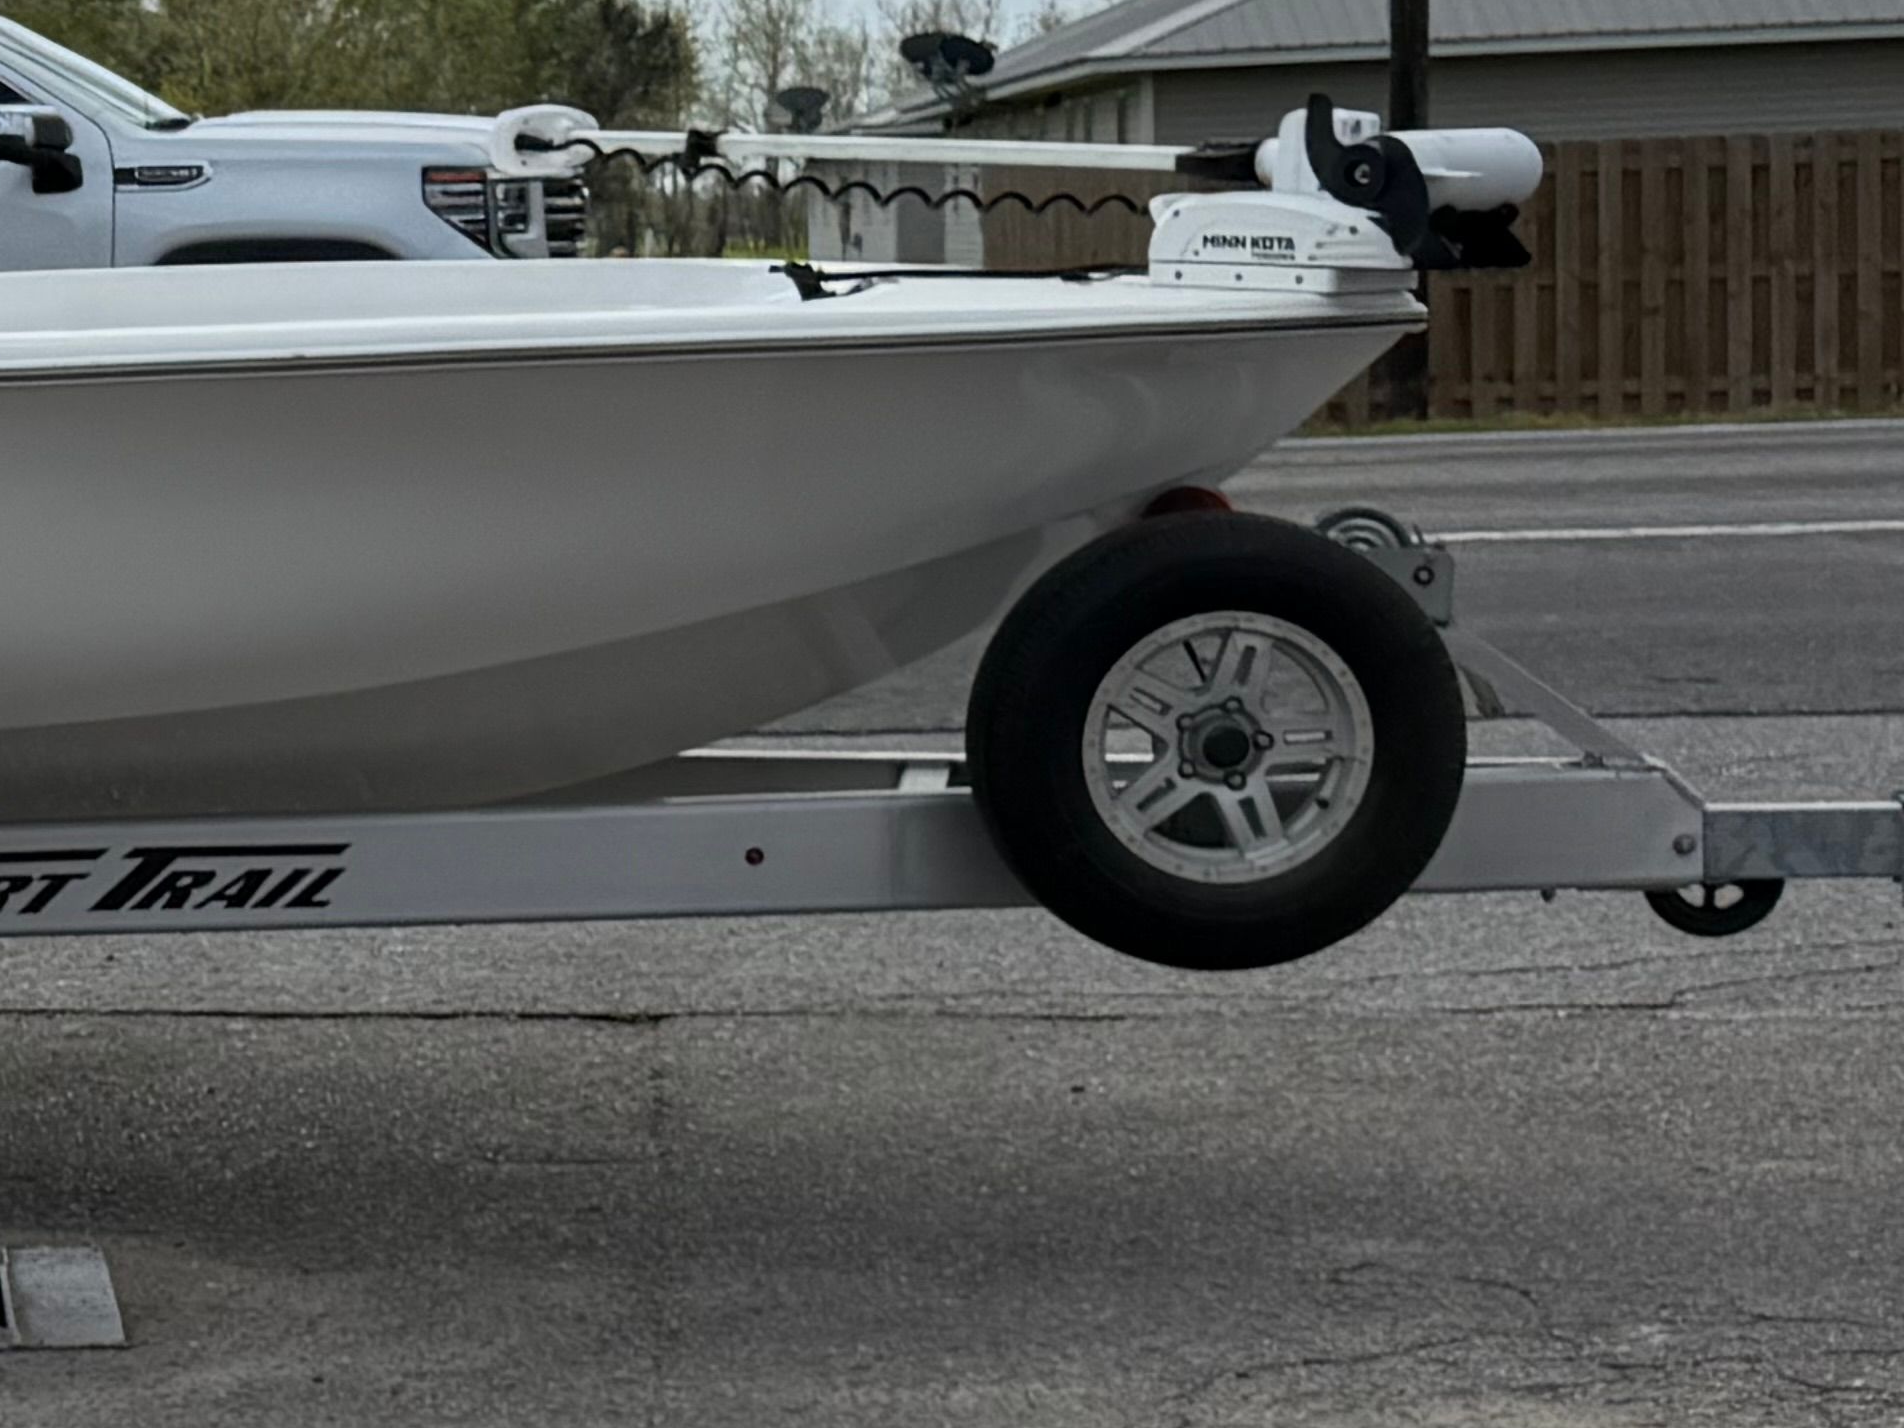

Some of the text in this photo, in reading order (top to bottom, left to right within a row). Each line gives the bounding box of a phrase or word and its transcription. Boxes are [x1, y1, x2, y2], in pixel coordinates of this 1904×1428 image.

[1202, 235, 1295, 251] MINN KOTA
[89, 844, 352, 912] TRAIL
